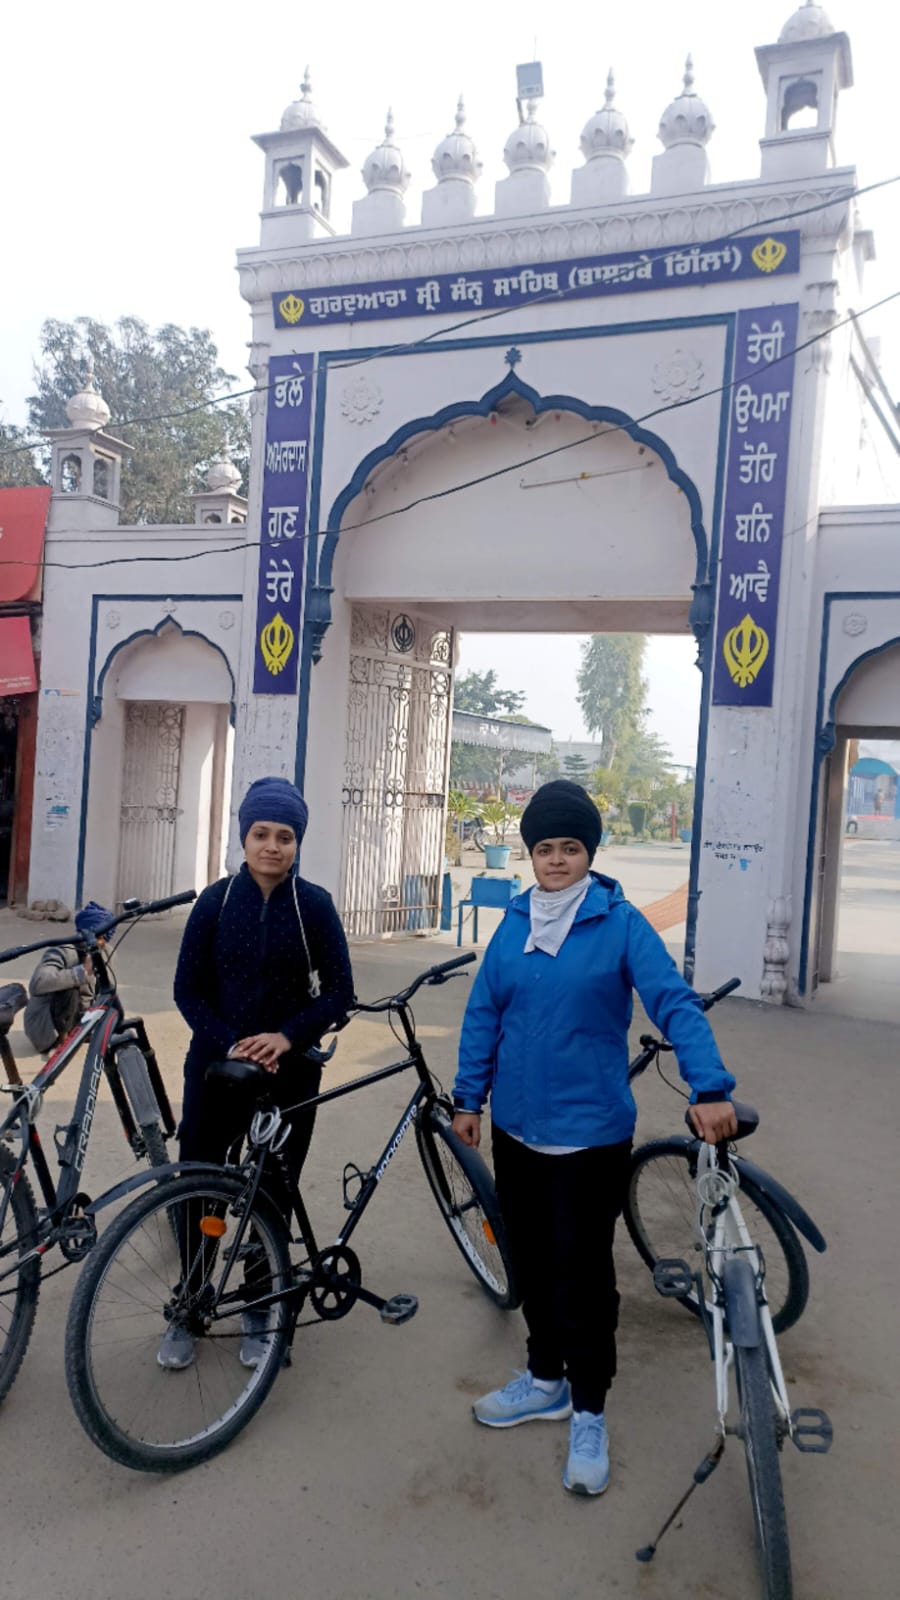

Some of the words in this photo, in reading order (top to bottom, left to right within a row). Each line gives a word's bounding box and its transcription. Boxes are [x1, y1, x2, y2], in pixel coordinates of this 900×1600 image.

[309, 289, 407, 318] ਗੁਰਦੁਆਰਾ
[416, 281, 440, 310] ਸ੍ਰੀ
[493, 269, 559, 296] ਸਾਹਿਬ
[747, 320, 785, 364] ਤੇਰੀ
[275, 361, 305, 408] ਭਲੇ
[736, 384, 790, 433] ਉਪਮਾ
[266, 440, 307, 473] ਅਮਰਦਾਸ
[739, 440, 777, 484] ਤੋਹਿ
[268, 506, 299, 547] ਗੁਣ
[735, 502, 773, 543] ਬਨਿ
[265, 559, 294, 602] ਤੇਰੇ
[729, 560, 771, 602] ਆਵੈ
